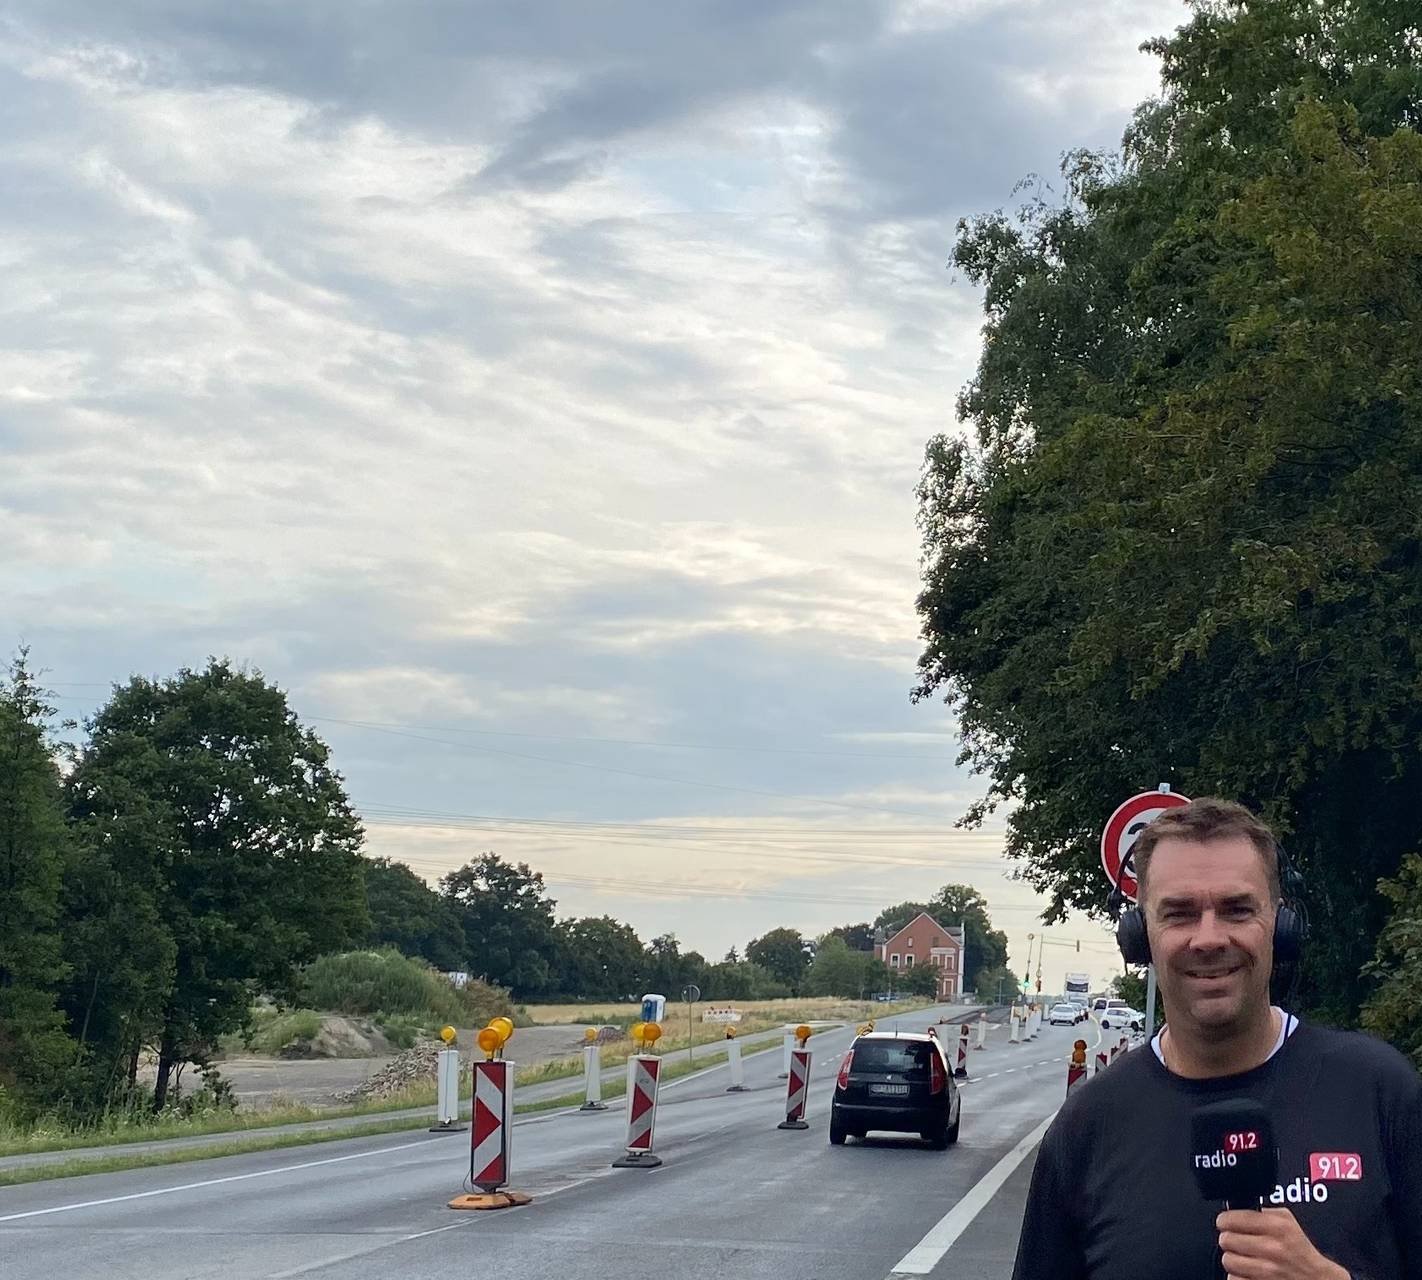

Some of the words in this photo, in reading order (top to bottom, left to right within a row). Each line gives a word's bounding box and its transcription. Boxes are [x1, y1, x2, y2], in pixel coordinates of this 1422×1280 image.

[1229, 1132, 1257, 1149] 91.2
[1195, 1150, 1237, 1168] radio
[1318, 1157, 1360, 1179] 91.2
[1260, 1178, 1328, 1204] adio
